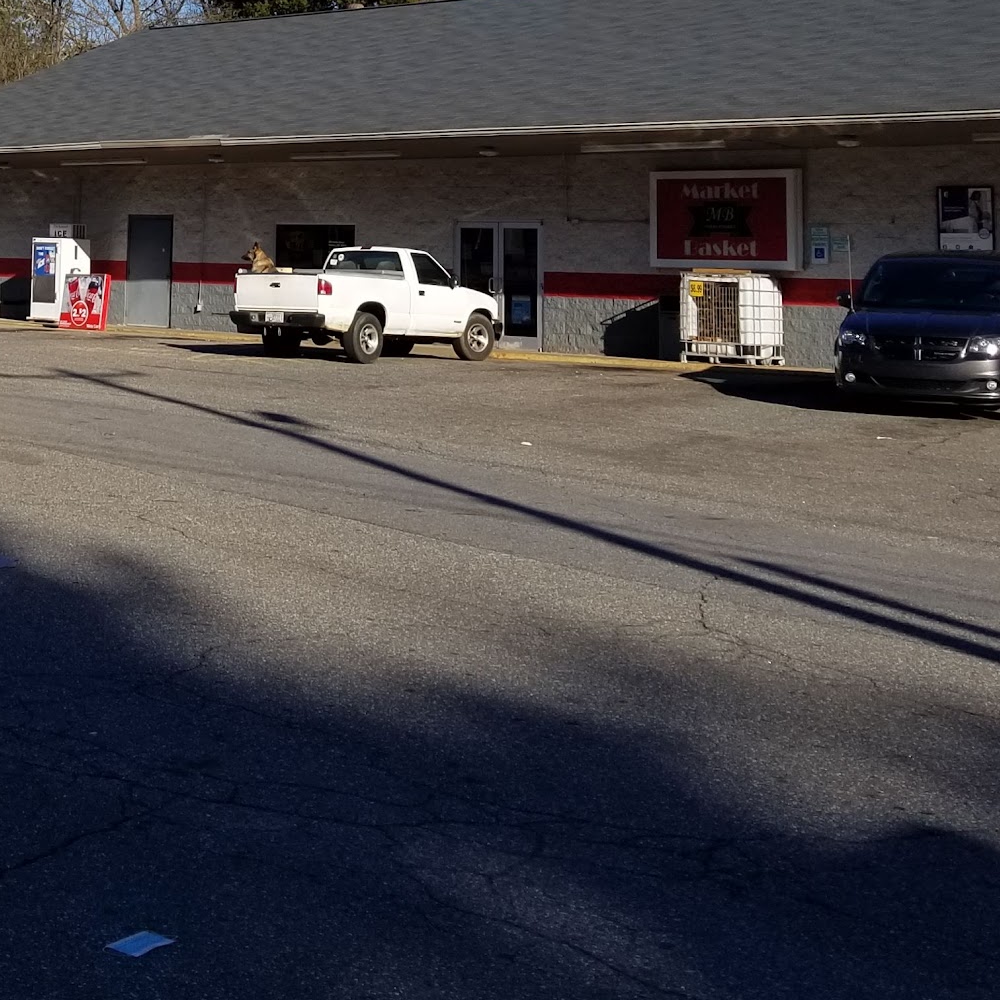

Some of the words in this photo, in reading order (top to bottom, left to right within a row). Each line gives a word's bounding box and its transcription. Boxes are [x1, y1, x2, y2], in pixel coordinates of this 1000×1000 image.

[680, 181, 760, 200] Market
[54, 229, 67, 238] ICE
[683, 239, 759, 257] Basket
